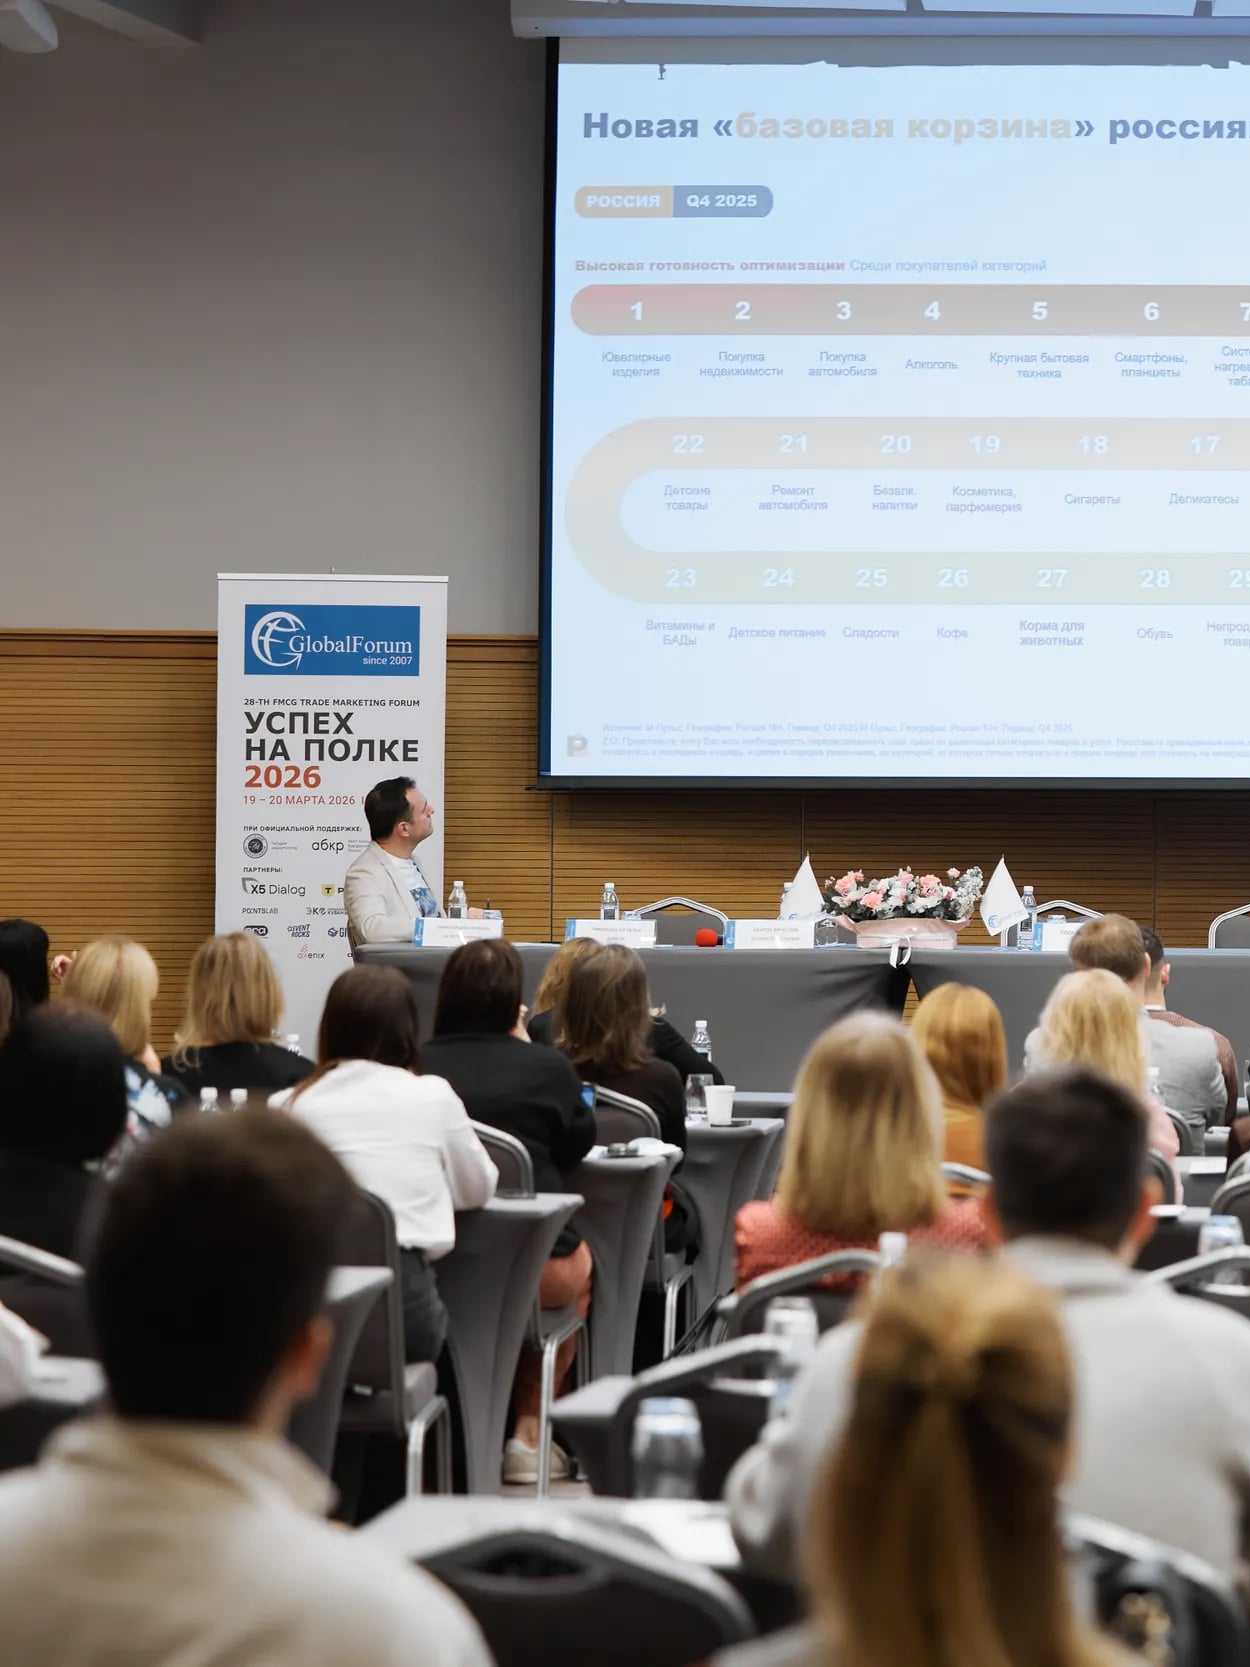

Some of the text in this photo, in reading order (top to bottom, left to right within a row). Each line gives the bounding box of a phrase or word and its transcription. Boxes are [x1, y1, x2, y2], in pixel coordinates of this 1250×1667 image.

[582, 113, 698, 138] Новая
[713, 110, 894, 138] «базовая
[907, 116, 1094, 144] корзина»
[586, 195, 661, 207] РОССИЯ
[687, 195, 757, 208] Q4 2025
[575, 260, 1046, 274] Высокая готовность оптимизации Среди покупателей категорий
[630, 301, 643, 320] 1
[735, 301, 750, 320] 2
[837, 301, 852, 320] 3
[925, 301, 940, 320] 4
[1033, 301, 1048, 320] 5
[1144, 301, 1159, 320] 6
[602, 352, 671, 364] Ювелирные
[718, 352, 765, 364] Покупка
[820, 352, 866, 364] Покупка
[906, 360, 957, 370] Алкоголь
[990, 353, 1089, 365] Крупная бытовая
[1115, 353, 1187, 366] Смартфоны,
[613, 367, 660, 378] изделия
[699, 366, 783, 378] недвижимости
[809, 367, 877, 377] автомобиля
[1017, 369, 1062, 379] техника
[1121, 368, 1180, 379] планшеты
[673, 434, 704, 454] 22
[779, 434, 808, 454] 21
[881, 434, 911, 454] 20
[970, 434, 1000, 454] 19
[1078, 434, 1108, 454] 18
[1190, 435, 1220, 455] 17
[666, 569, 696, 588] 23
[763, 569, 794, 588] 24
[856, 569, 887, 588] 25
[937, 569, 969, 588] 26
[1037, 569, 1068, 588] 27
[1140, 569, 1171, 589] 28
[289, 636, 412, 654] GlobalForum
[363, 656, 412, 665] since 2007
[244, 712, 354, 734] УСПЕХ
[246, 739, 419, 762] НА ПОЛКЕ
[244, 765, 321, 788] 2026
[244, 796, 355, 805] 19 20 МАРТА 2026
[312, 839, 344, 854] абкр
[251, 885, 305, 896] X5 Dialog
